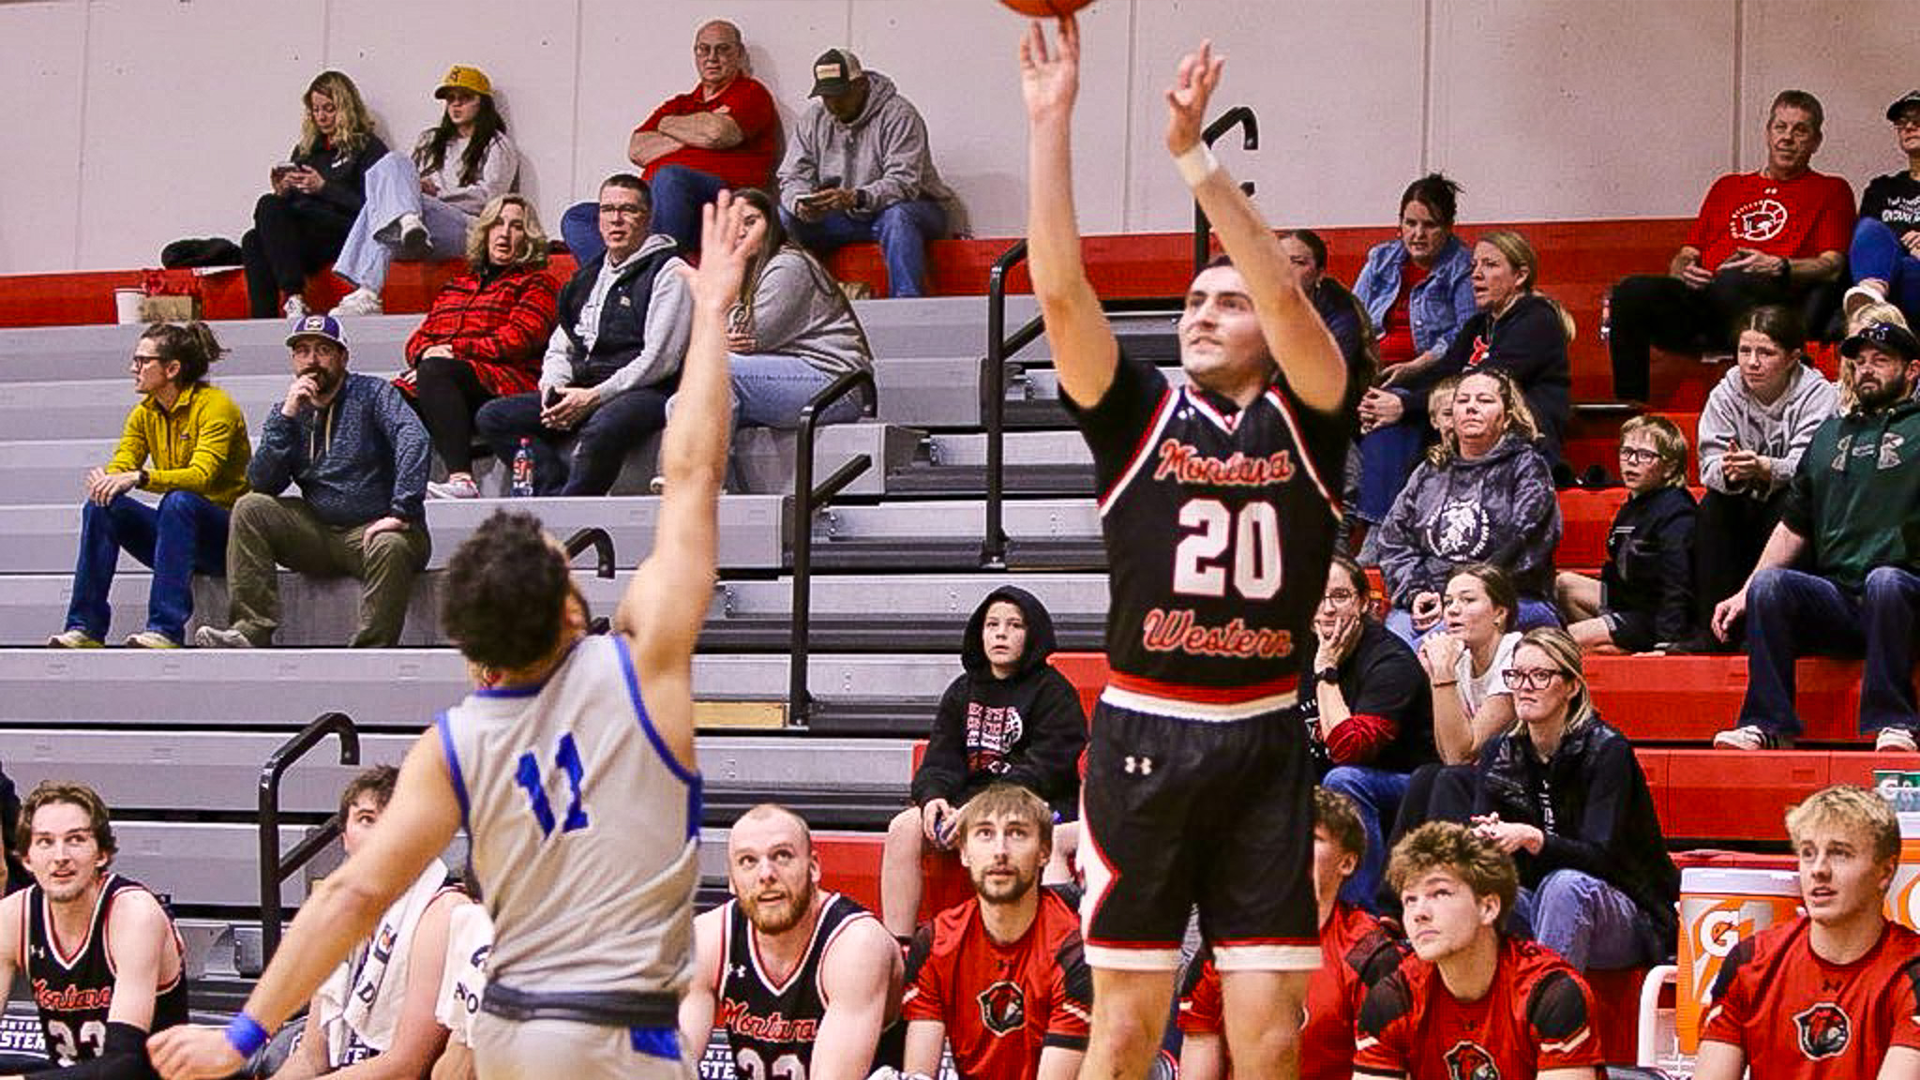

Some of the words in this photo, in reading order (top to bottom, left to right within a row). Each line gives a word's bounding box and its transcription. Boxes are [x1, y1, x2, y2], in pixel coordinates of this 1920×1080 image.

[1153, 438, 1296, 485] Montana
[1173, 498, 1283, 600] 20
[1142, 608, 1294, 658] Western
[513, 731, 590, 841] 11
[1700, 908, 1740, 957] G
[721, 996, 819, 1044] Montana
